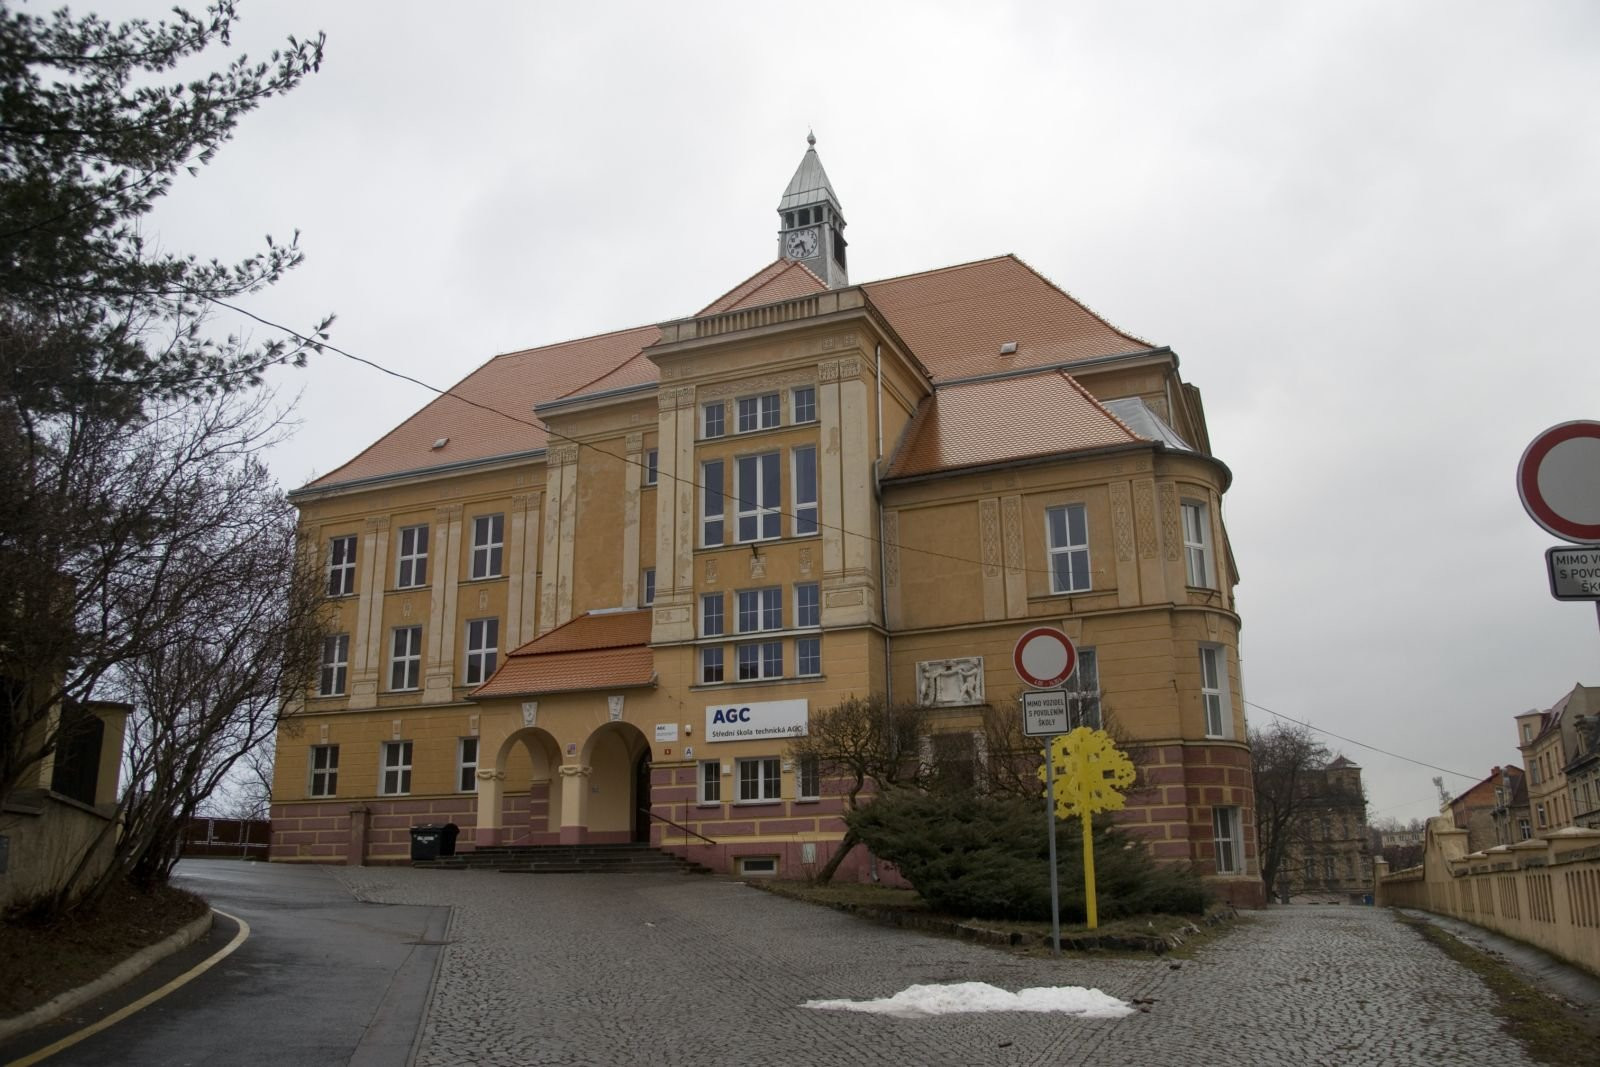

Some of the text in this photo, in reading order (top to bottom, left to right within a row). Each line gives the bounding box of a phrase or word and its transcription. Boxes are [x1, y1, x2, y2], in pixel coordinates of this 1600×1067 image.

[1556, 554, 1600, 565] MIMO V
[1559, 569, 1568, 579] S
[1581, 580, 1600, 593] ŠK
[1042, 698, 1064, 706] VOZIDEL
[712, 707, 751, 724] AGC
[712, 729, 735, 738] Střední
[736, 727, 753, 736] škola
[755, 725, 786, 735] technická
